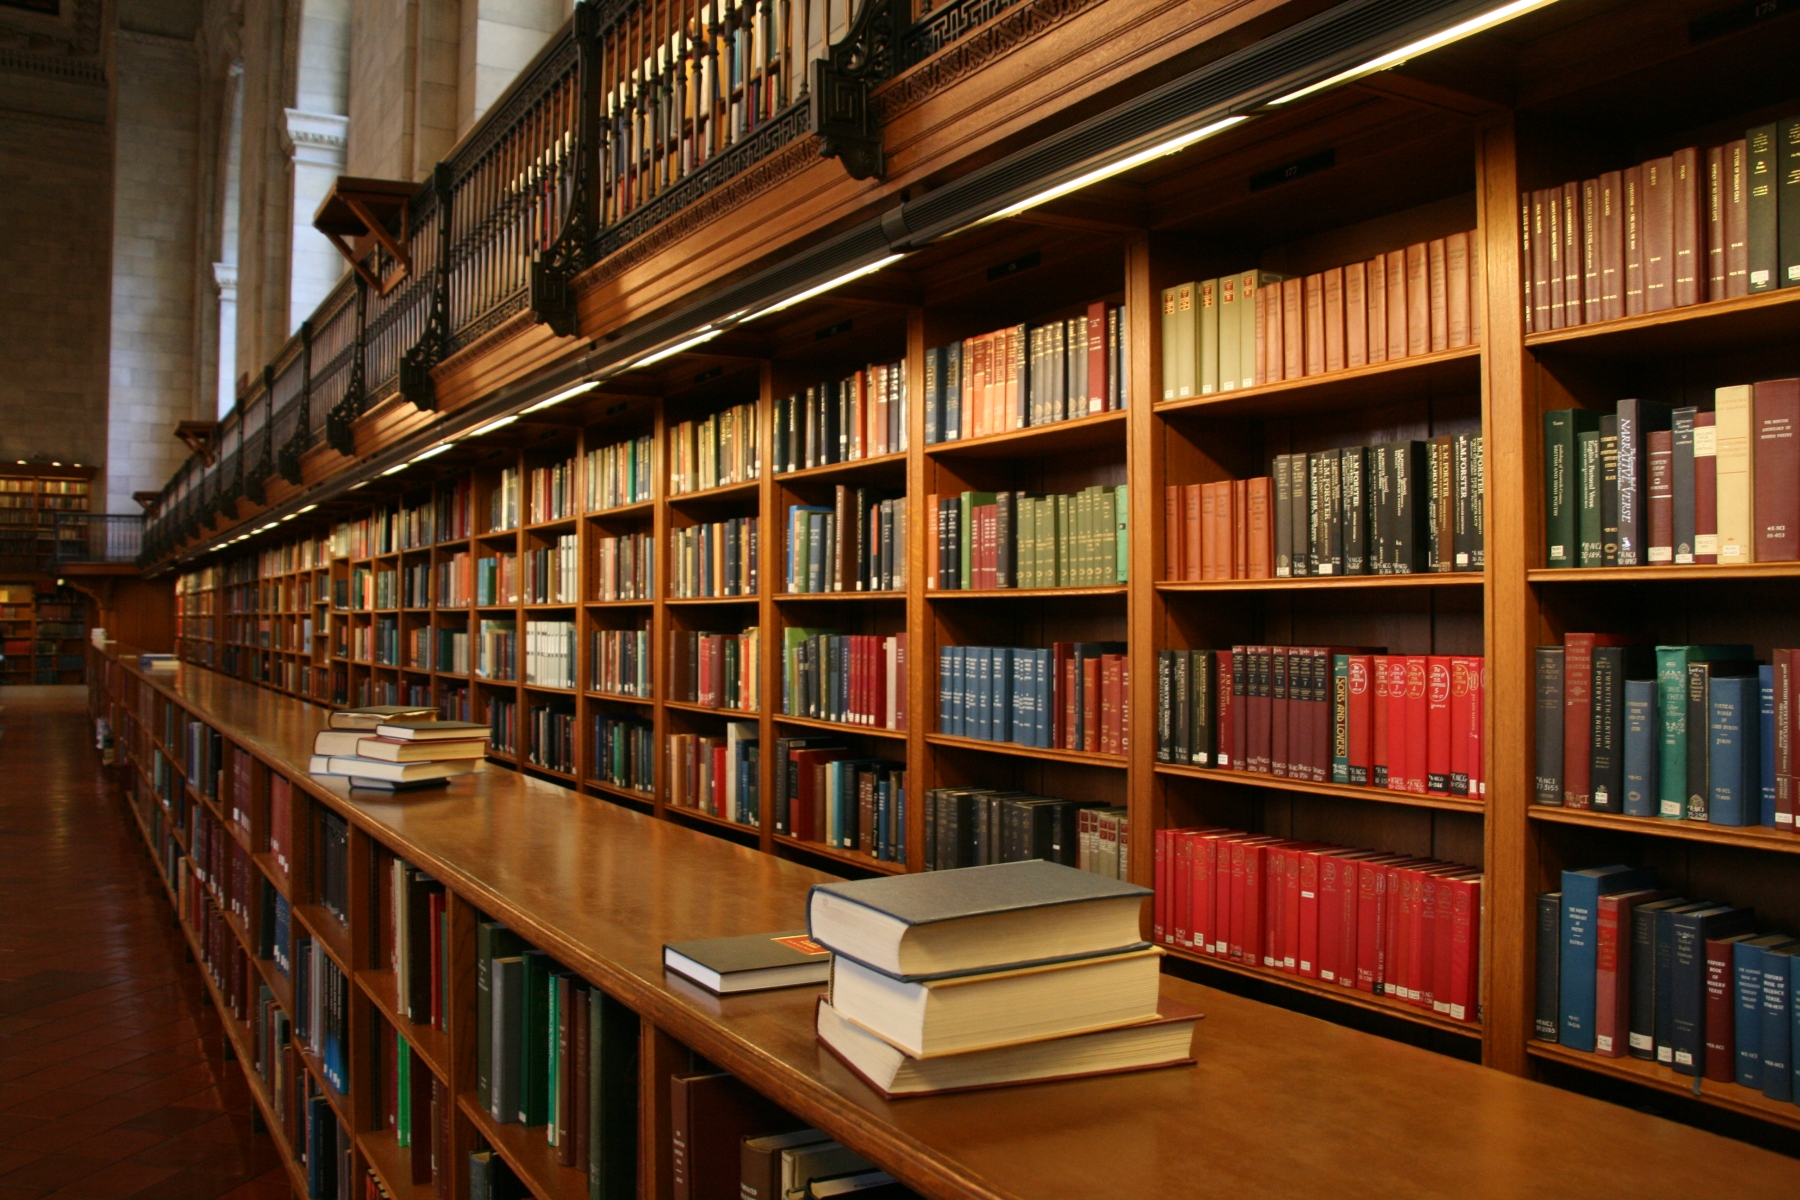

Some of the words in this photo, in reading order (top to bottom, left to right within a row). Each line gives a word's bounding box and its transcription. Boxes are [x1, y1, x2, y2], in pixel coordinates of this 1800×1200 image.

[1621, 418, 1631, 482] NARRATIVE
[1622, 488, 1631, 523] VERSE
[1336, 678, 1344, 702] SONS
[1337, 723, 1345, 755] LOVERS
[1763, 987, 1784, 996] REGENCY
